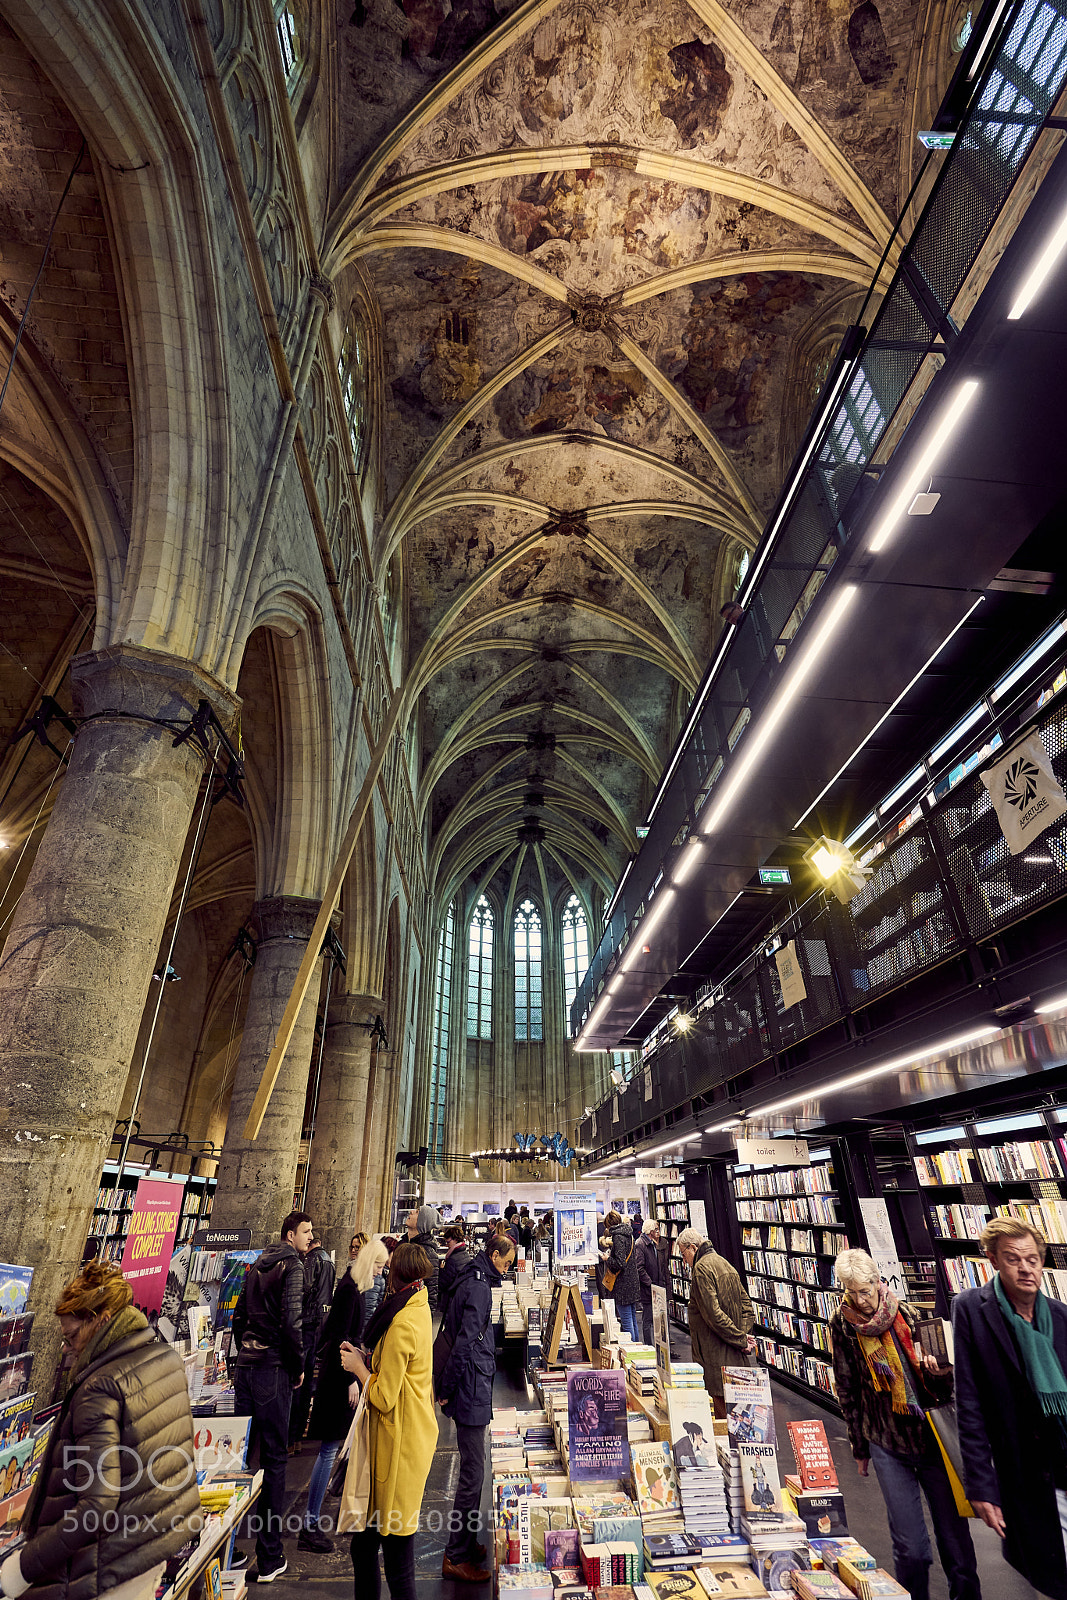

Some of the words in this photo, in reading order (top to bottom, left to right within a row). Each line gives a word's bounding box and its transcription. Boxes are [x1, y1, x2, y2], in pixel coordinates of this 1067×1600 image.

[1019, 796, 1048, 827] APERTURE
[128, 1211, 156, 1235] ROLLING
[154, 1211, 178, 1233] STONES
[205, 1232, 240, 1243] teNeues
[131, 1234, 165, 1260] COMPLEET
[573, 1377, 604, 1392] WORDS
[604, 1389, 621, 1401] FIRE
[574, 1440, 622, 1448] TAMINO
[802, 1440, 824, 1448] LAATSTE
[740, 1446, 774, 1457] TRASHED
[800, 1447, 811, 1455] DAG
[575, 1460, 600, 1468] ANNELIES
[639, 1455, 666, 1466] MENSEN
[812, 1460, 830, 1468] LEVEN
